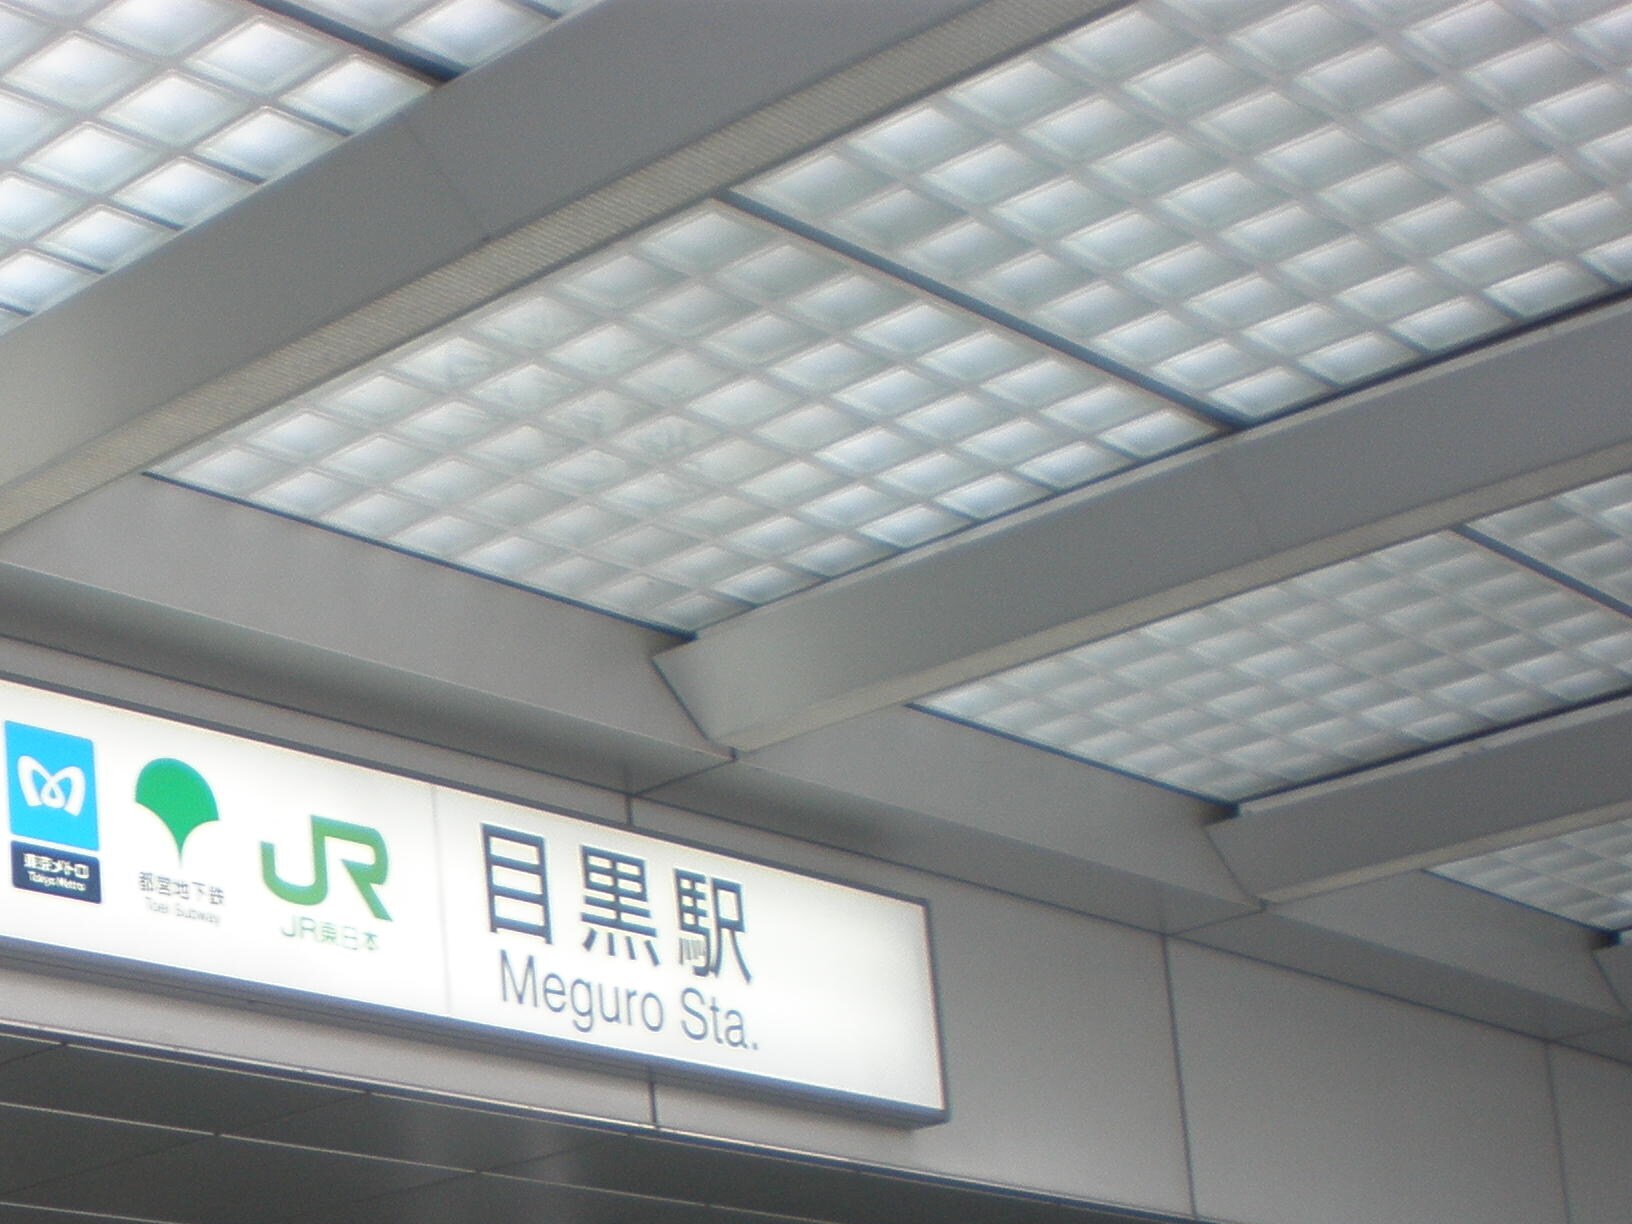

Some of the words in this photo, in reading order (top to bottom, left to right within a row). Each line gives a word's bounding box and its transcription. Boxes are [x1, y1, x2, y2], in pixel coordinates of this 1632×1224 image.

[23, 852, 89, 878] 東京メトロ
[28, 870, 57, 887] Tokyo
[57, 876, 86, 891] Metro
[260, 814, 392, 922] JR
[139, 871, 226, 905] 都営地下鉄
[480, 822, 752, 985] 目黒駅
[279, 915, 379, 951] JR東日本
[499, 949, 664, 1033] Meguro
[680, 986, 759, 1051] Sta.
